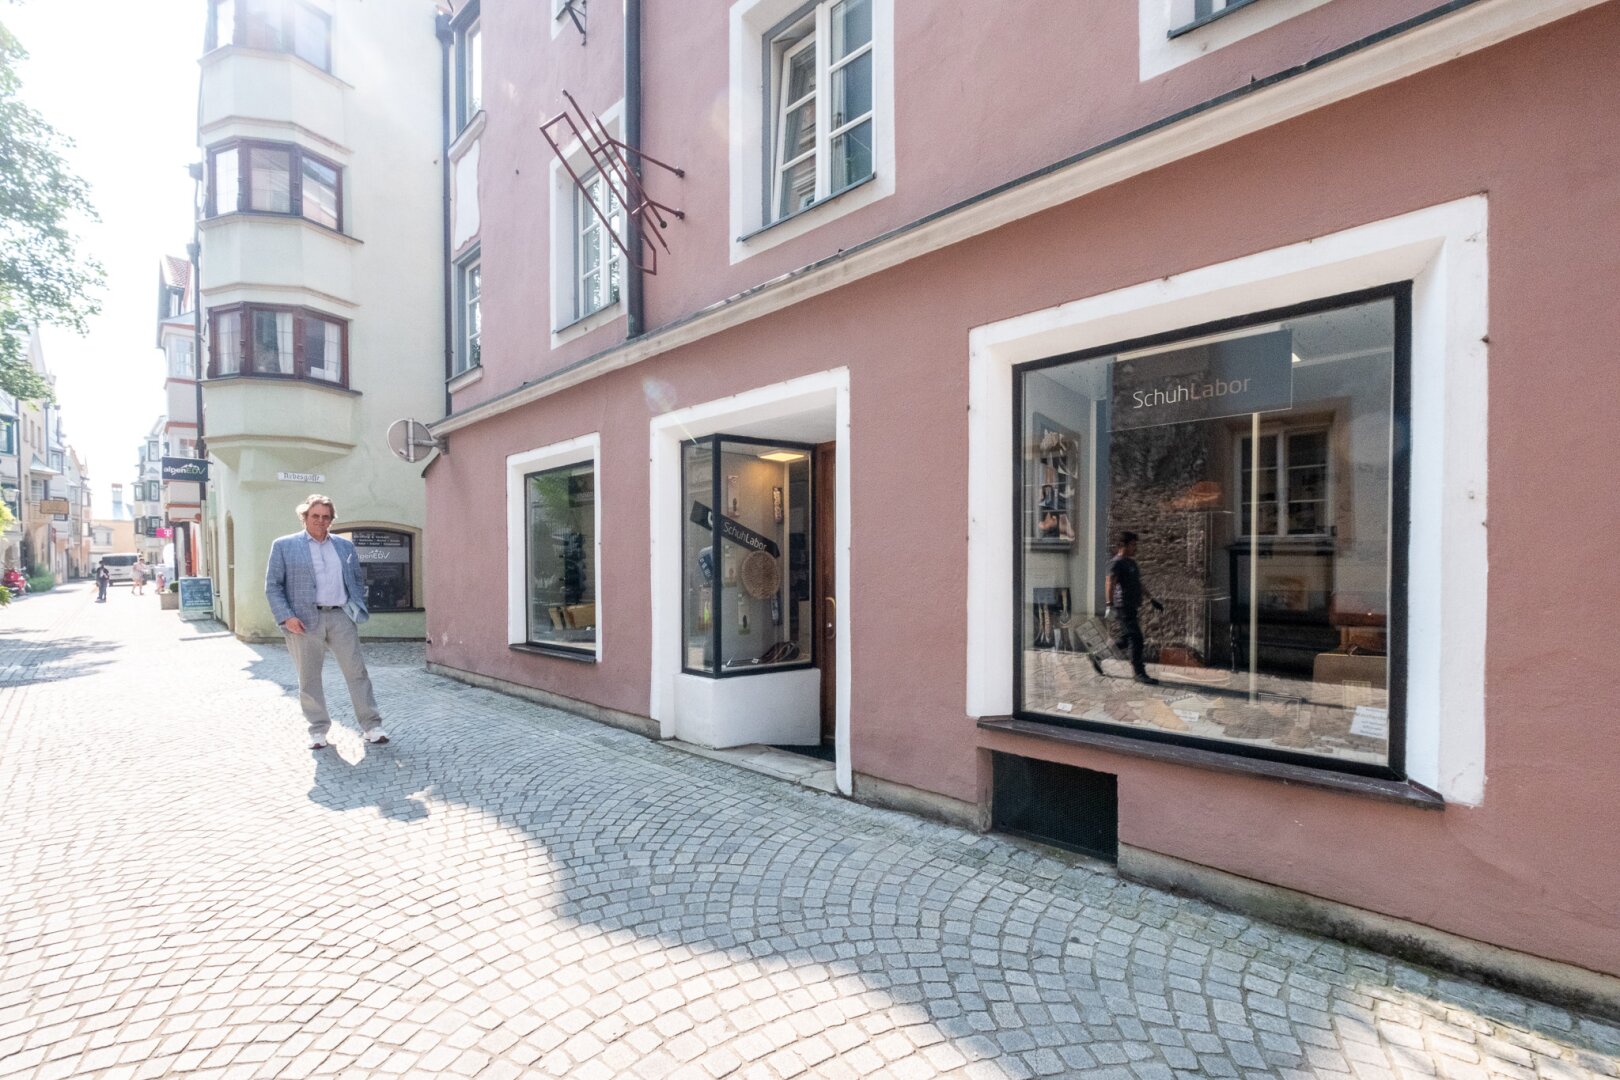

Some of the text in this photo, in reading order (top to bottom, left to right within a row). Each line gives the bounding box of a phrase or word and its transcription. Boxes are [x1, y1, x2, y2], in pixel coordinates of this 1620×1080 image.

[1132, 378, 1251, 409] SchuhLabor
[724, 521, 768, 550] SchuhLabor
[357, 551, 391, 561] lpenEDV
